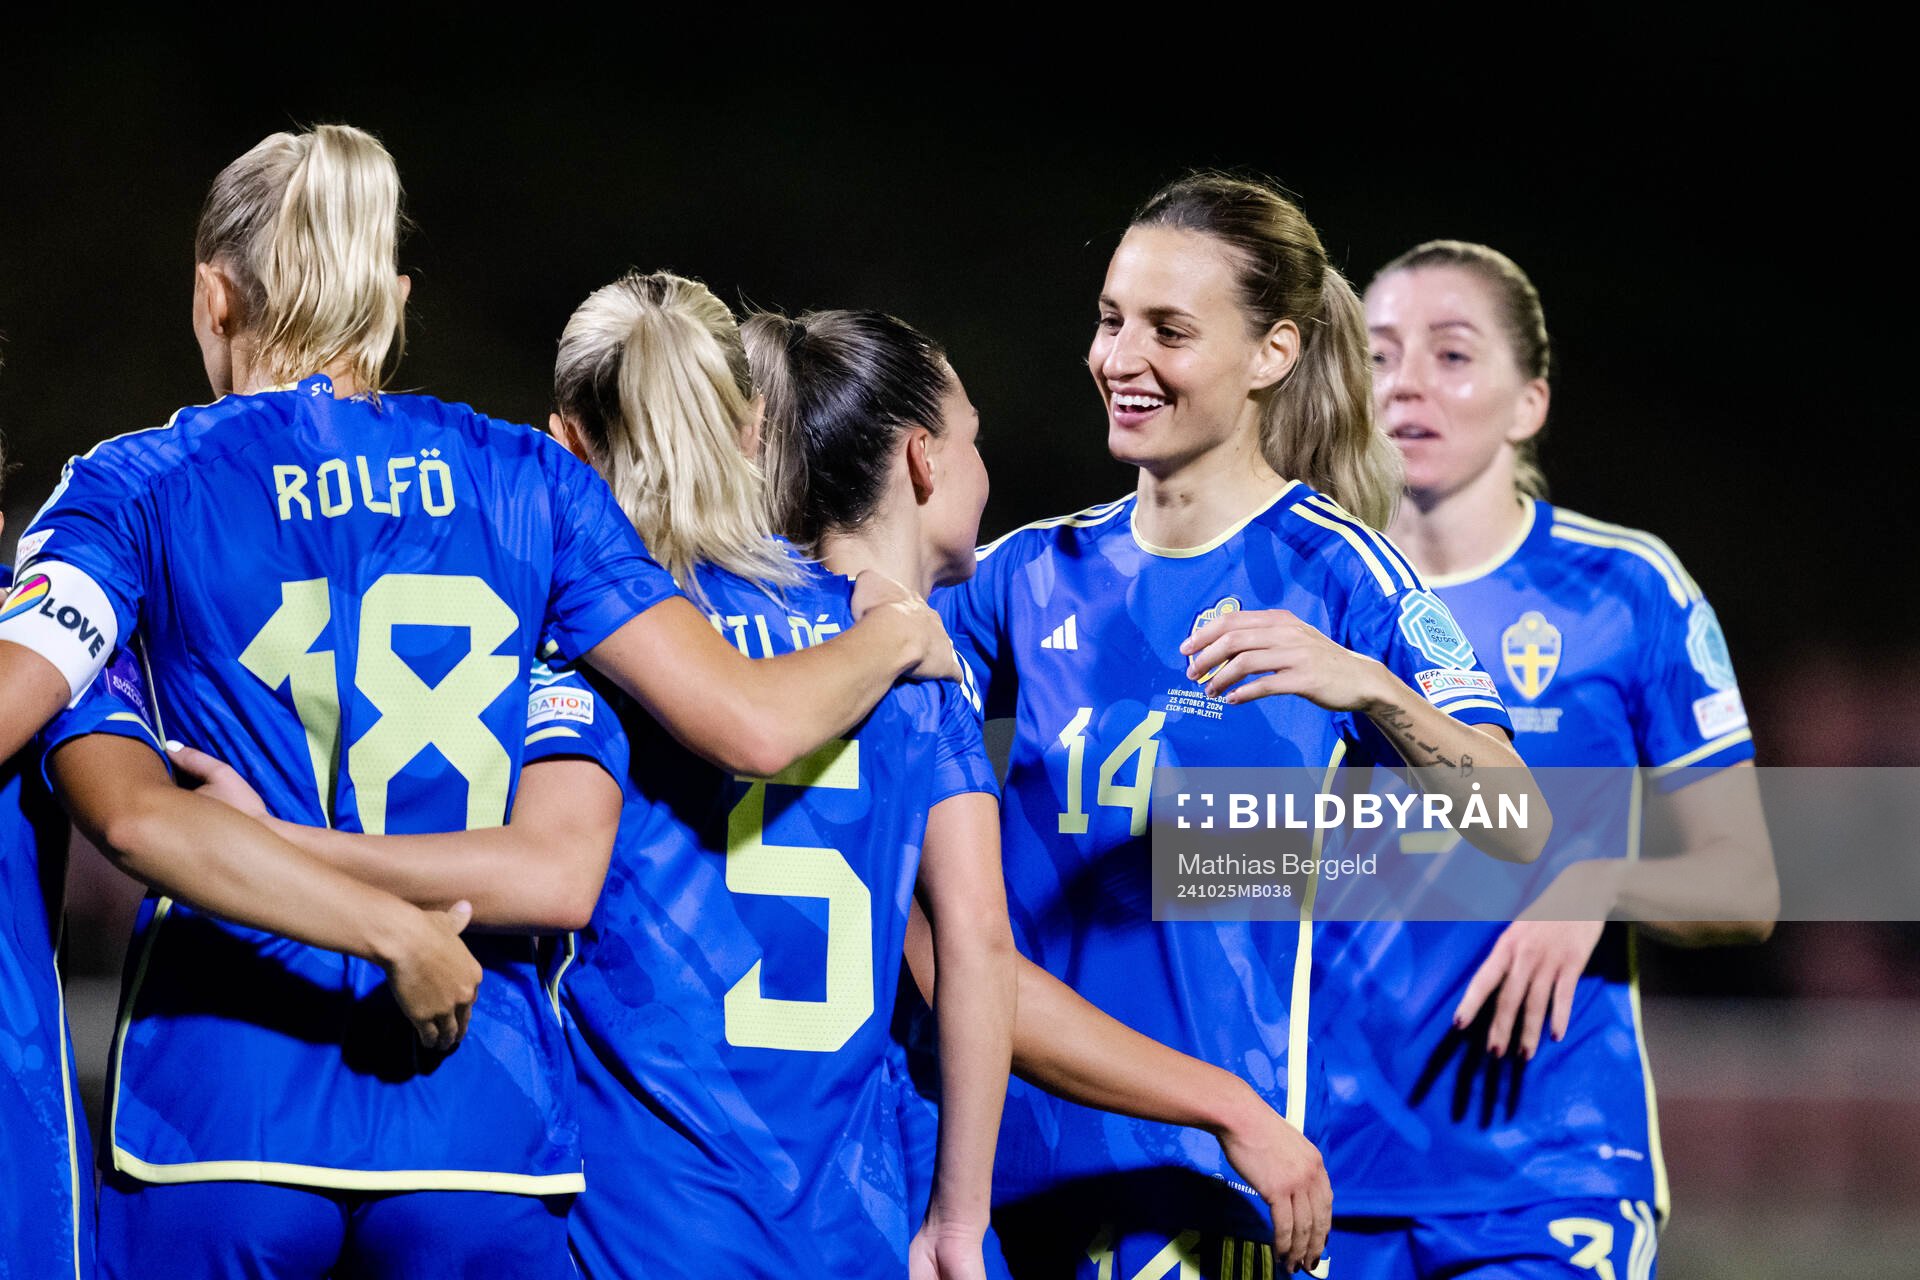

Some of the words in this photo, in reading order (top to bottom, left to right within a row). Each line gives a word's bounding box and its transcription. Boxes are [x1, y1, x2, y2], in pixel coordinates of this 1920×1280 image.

[273, 448, 456, 521] ROLFÖ
[39, 598, 105, 659] LOVE
[238, 573, 520, 836] 18
[1179, 698, 1205, 708] OCTOBER
[1206, 702, 1224, 712] 2024
[1418, 671, 1441, 681] UEFA
[1058, 707, 1167, 836] 14
[724, 739, 874, 1052] 5
